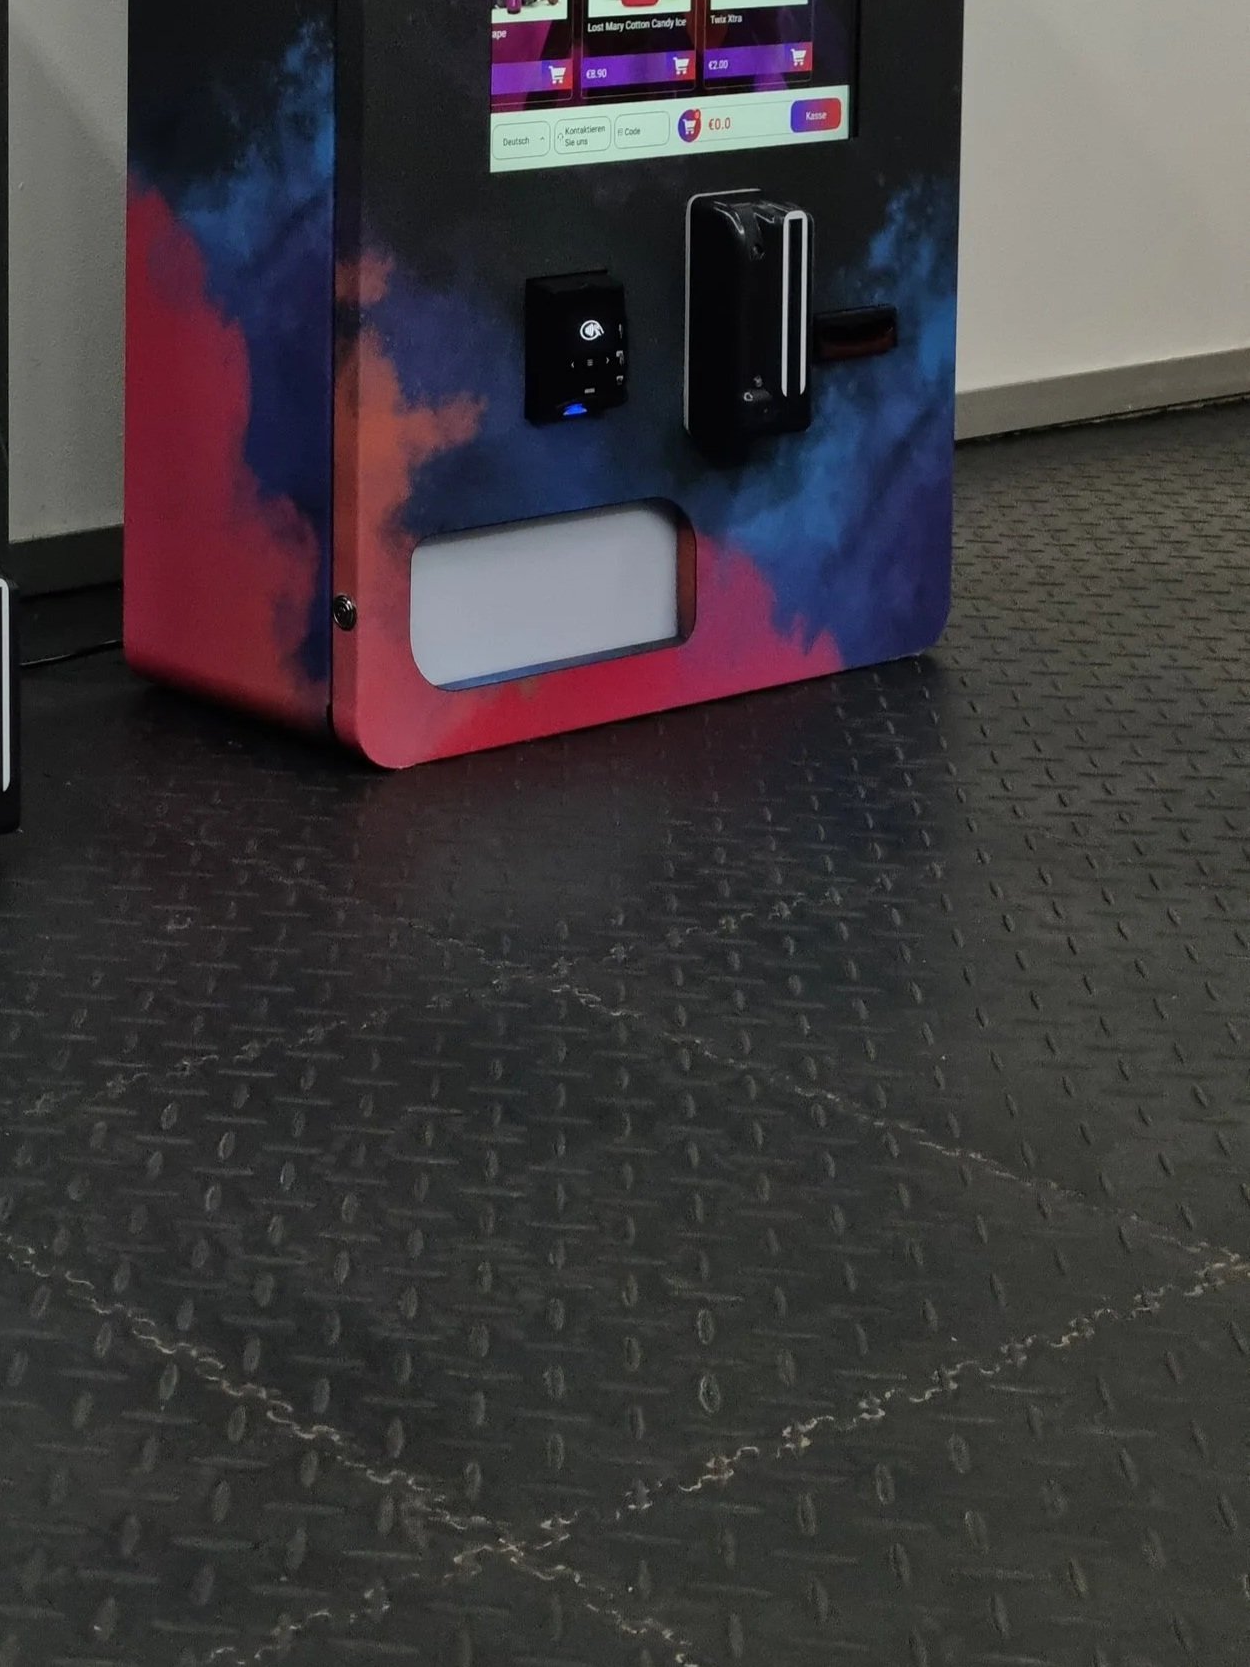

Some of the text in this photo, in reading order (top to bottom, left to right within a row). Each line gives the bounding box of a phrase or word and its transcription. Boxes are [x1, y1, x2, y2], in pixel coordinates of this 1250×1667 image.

[710, 14, 743, 24] Twix Xtra
[587, 17, 687, 34] Lost Mary Cotton Candy Ice
[492, 29, 507, 40] ape
[805, 111, 827, 121] Kasse
[708, 117, 731, 130] €0.0
[564, 124, 606, 135] Kontaktieren
[624, 127, 641, 136] Code
[502, 137, 530, 147] Deutsch
[564, 138, 588, 147] Sie uns
